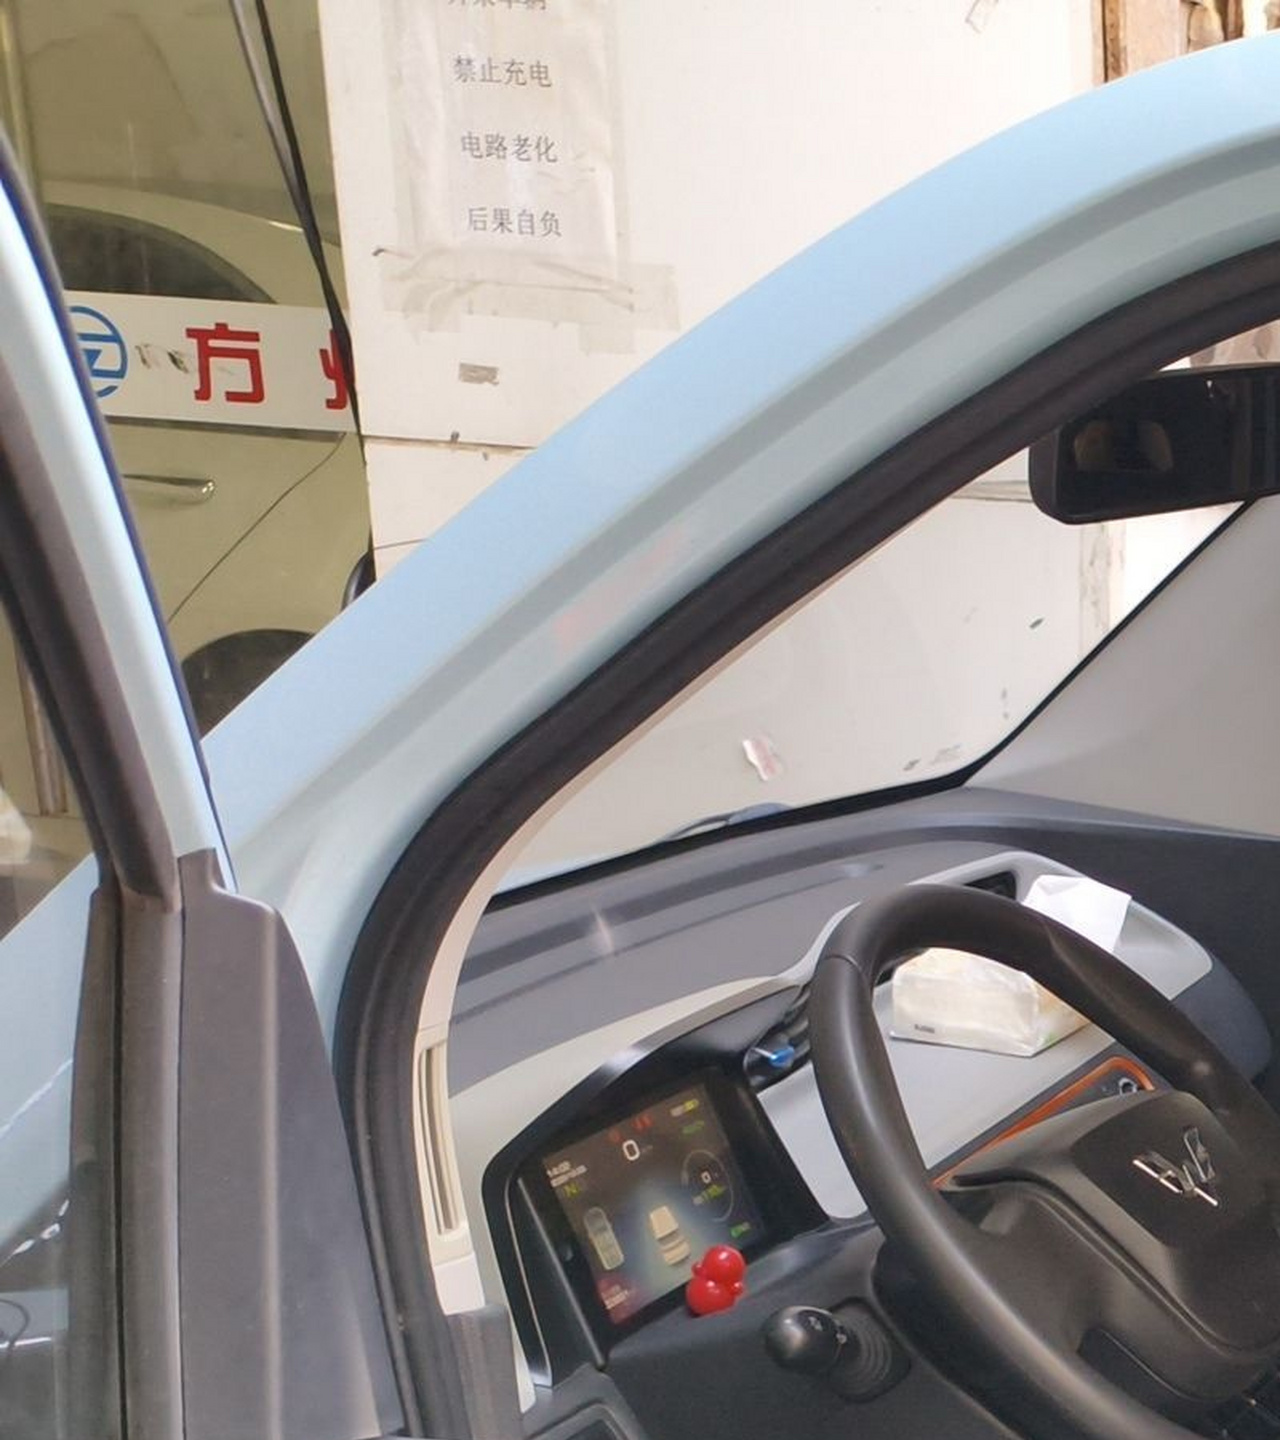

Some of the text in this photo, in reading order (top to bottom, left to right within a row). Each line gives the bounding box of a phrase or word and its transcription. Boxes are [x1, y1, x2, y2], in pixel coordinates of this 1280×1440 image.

[454, 56, 552, 87] 禁止充电
[461, 132, 558, 163] 电路老化
[467, 207, 562, 237] 后果自负
